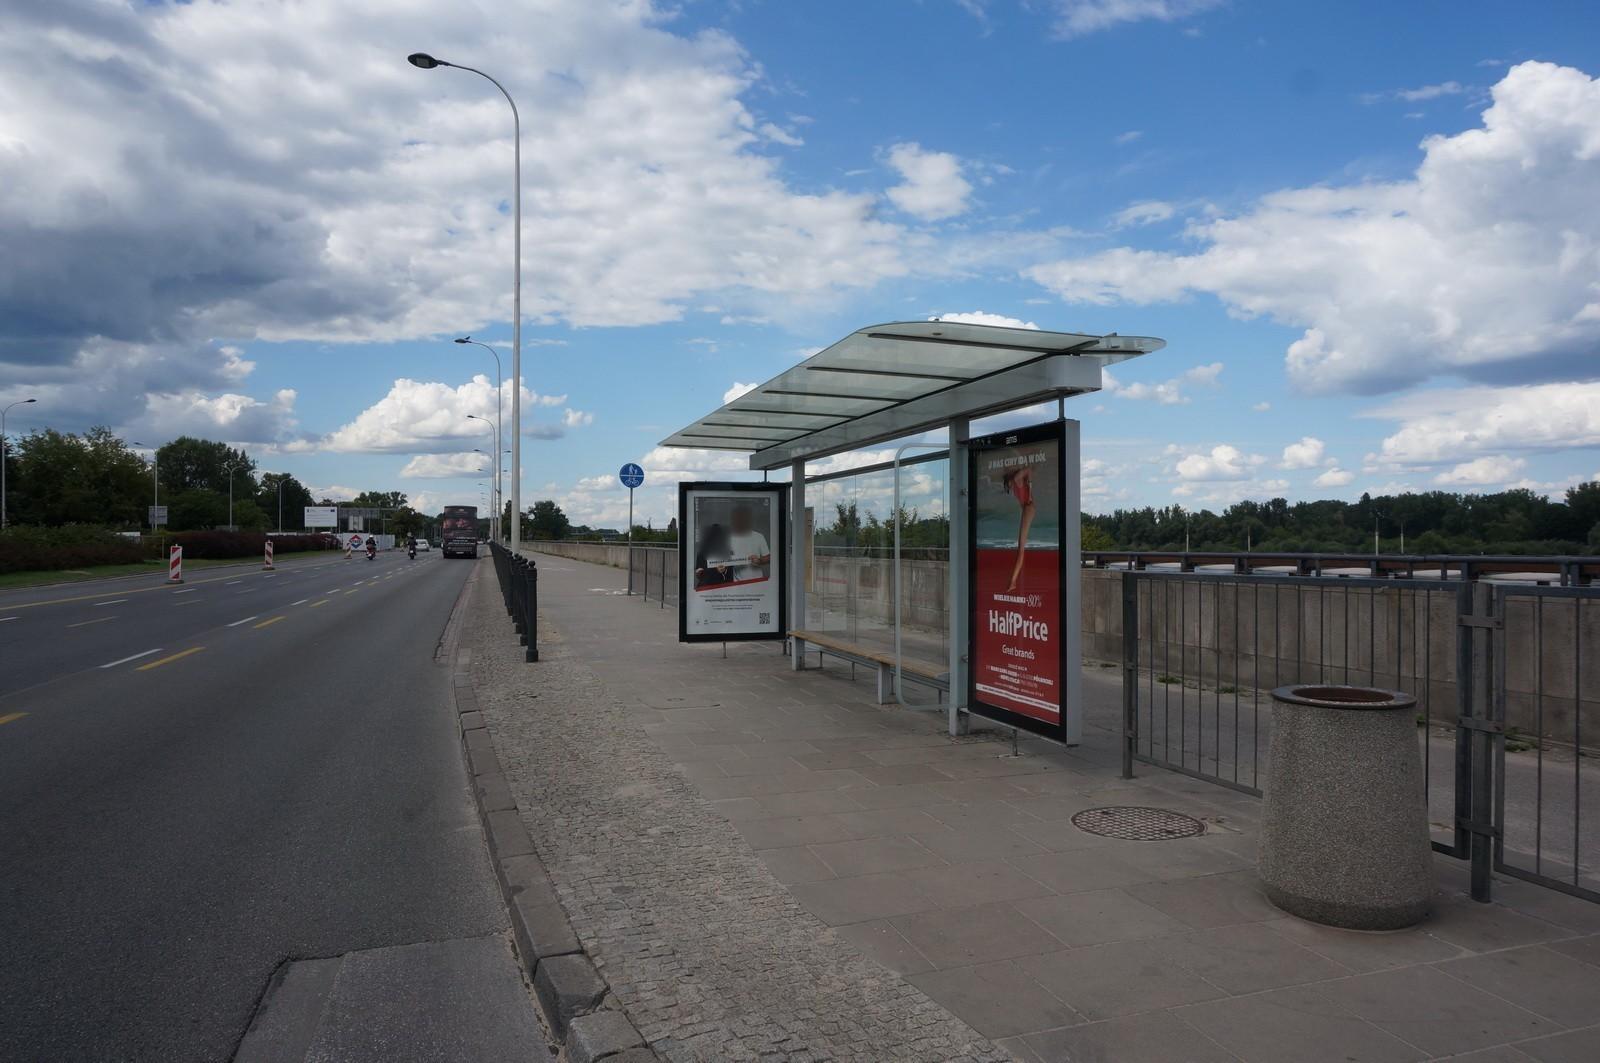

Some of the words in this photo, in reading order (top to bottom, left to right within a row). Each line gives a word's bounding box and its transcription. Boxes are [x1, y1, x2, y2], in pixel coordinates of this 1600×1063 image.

[988, 609, 1048, 642] HalfPrice
[1002, 644, 1014, 656] Great
[1014, 648, 1035, 660] brands
